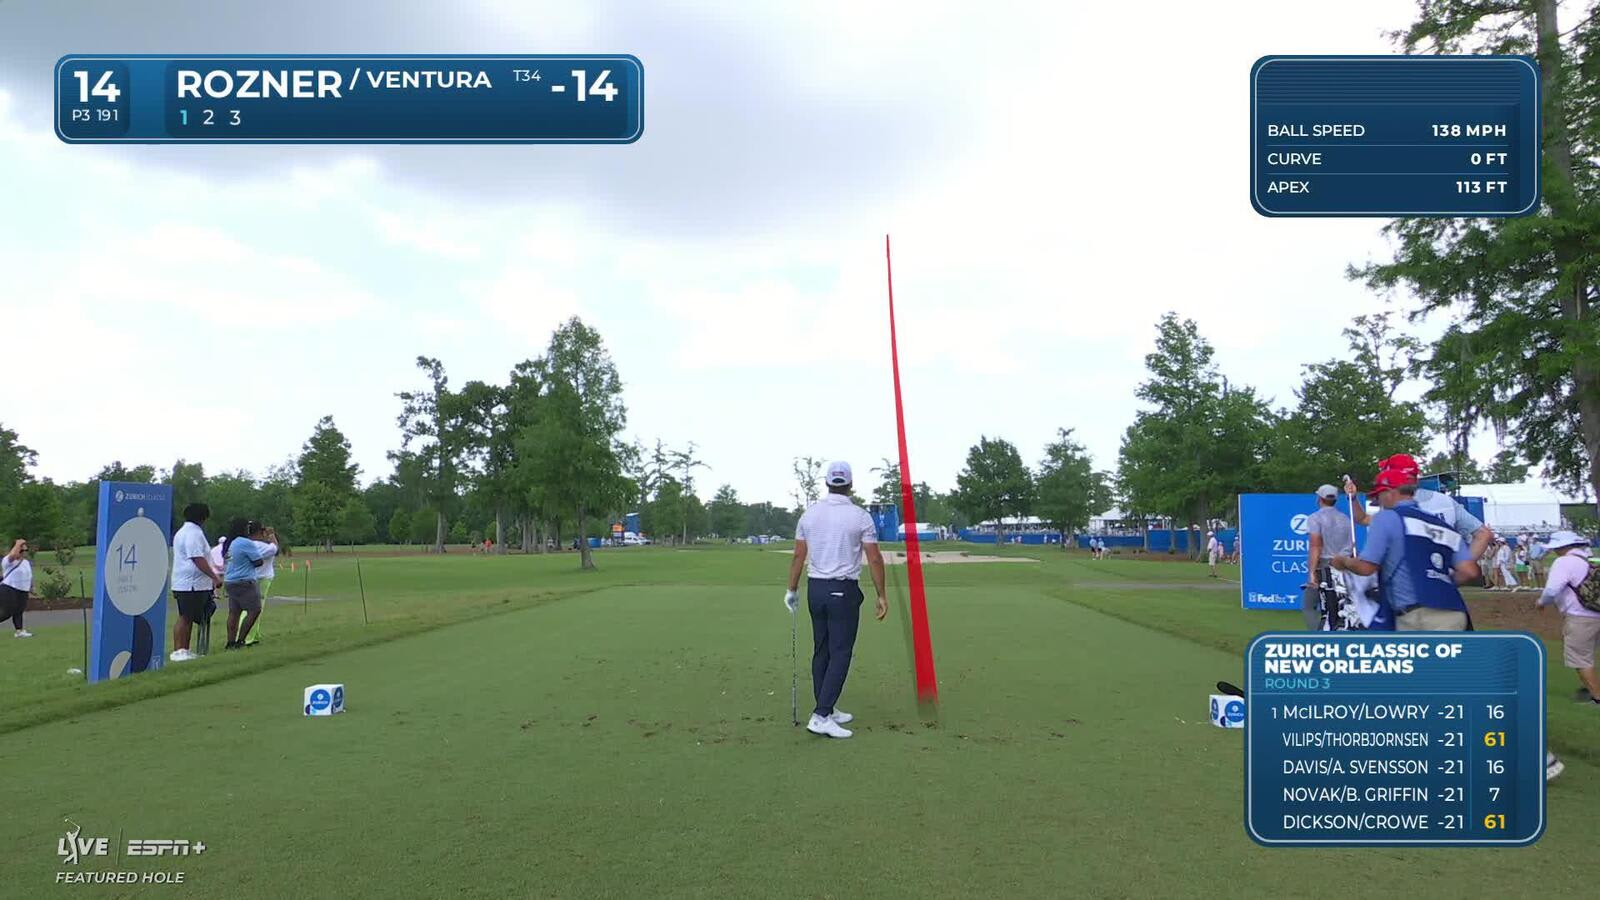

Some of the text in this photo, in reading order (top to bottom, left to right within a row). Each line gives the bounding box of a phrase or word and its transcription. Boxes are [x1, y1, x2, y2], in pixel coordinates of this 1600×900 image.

[1273, 540, 1309, 551] ZURI
[116, 543, 138, 572] 14
[1272, 561, 1309, 573] CLAS
